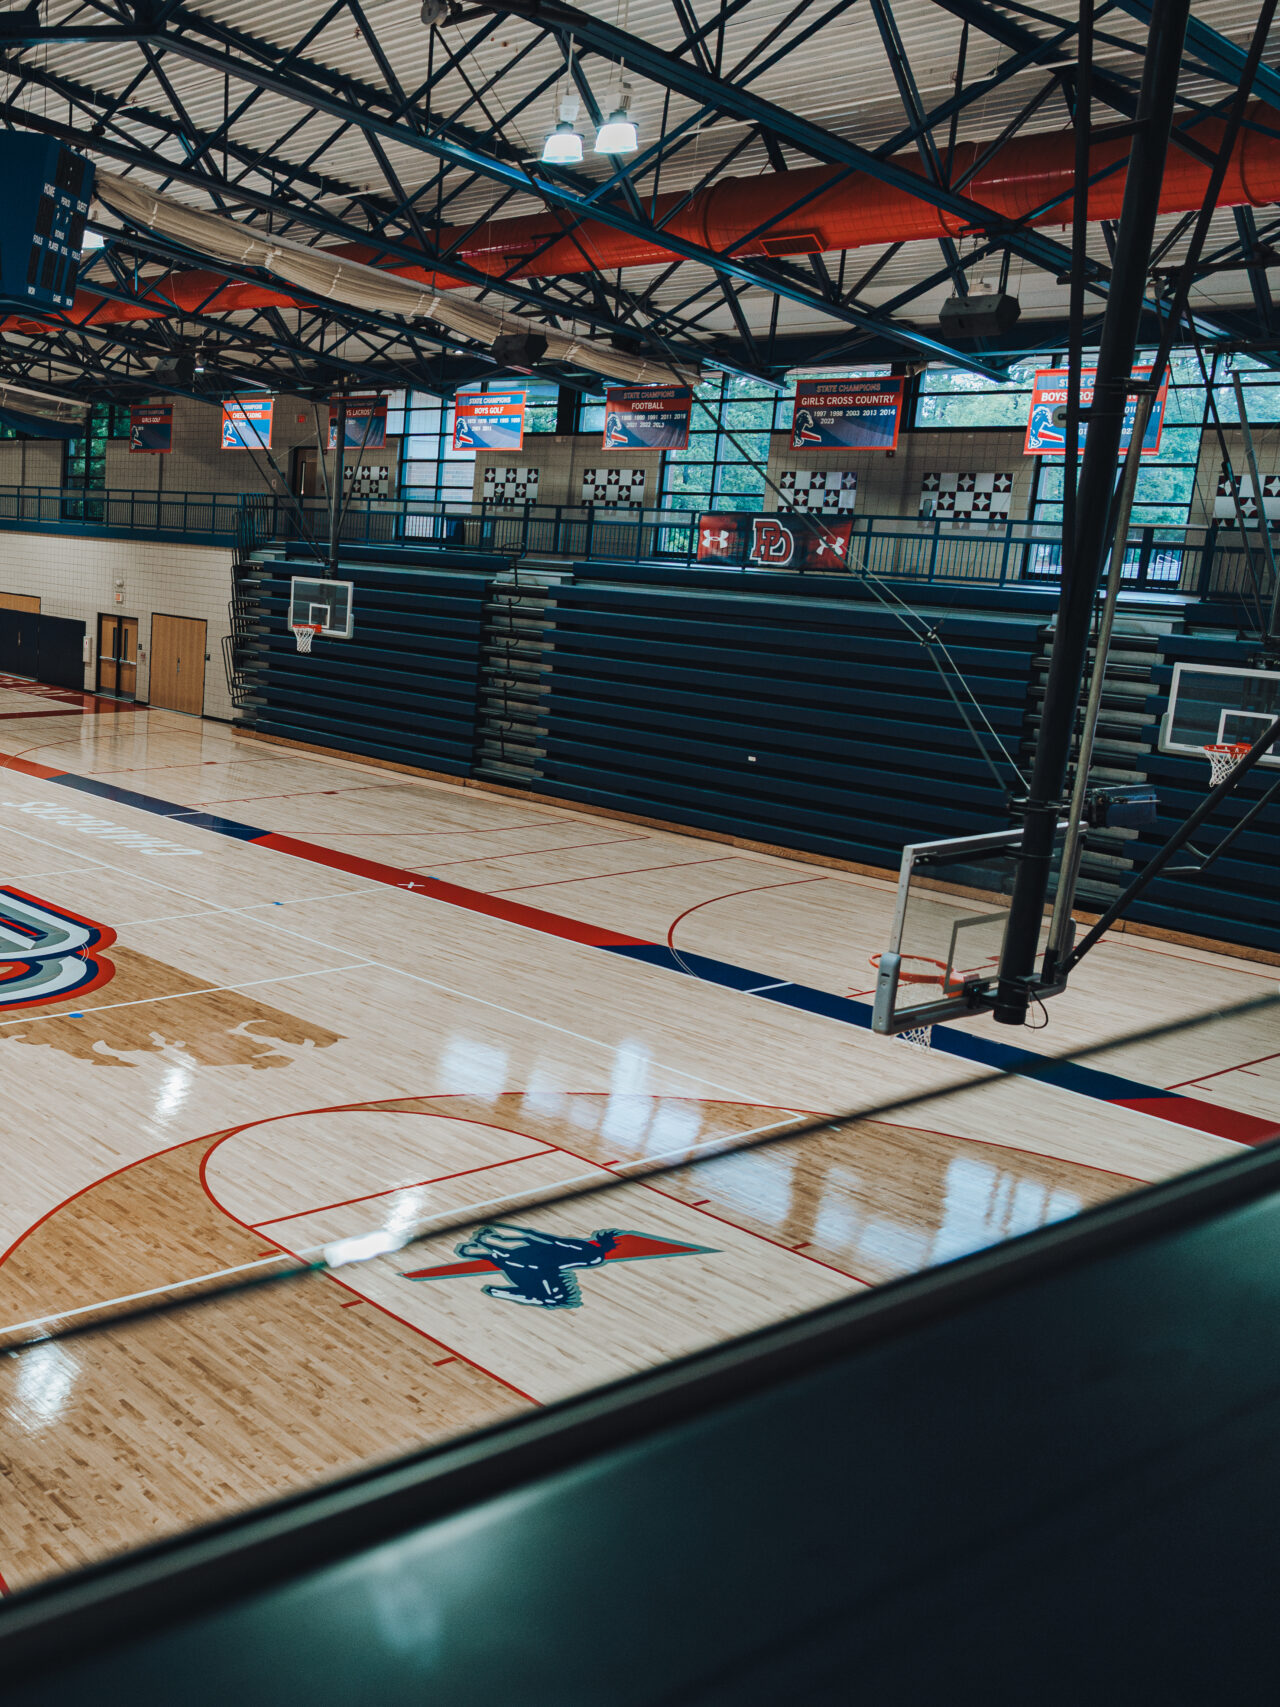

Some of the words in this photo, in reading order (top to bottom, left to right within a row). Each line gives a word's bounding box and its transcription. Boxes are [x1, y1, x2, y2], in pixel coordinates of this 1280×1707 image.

[816, 385, 837, 393] STATE
[838, 383, 881, 392] CHAMPIONS
[641, 390, 675, 399] CHAMPIONS
[1041, 391, 1068, 401] BOYS
[801, 397, 825, 406] GIRLS
[827, 396, 853, 405] CROSS
[855, 395, 895, 404] COUNTRY
[489, 406, 504, 414] GOLF
[631, 402, 664, 410] FOOTBALL
[880, 408, 896, 416] 2014
[1, 801, 205, 856] CHARGERS
